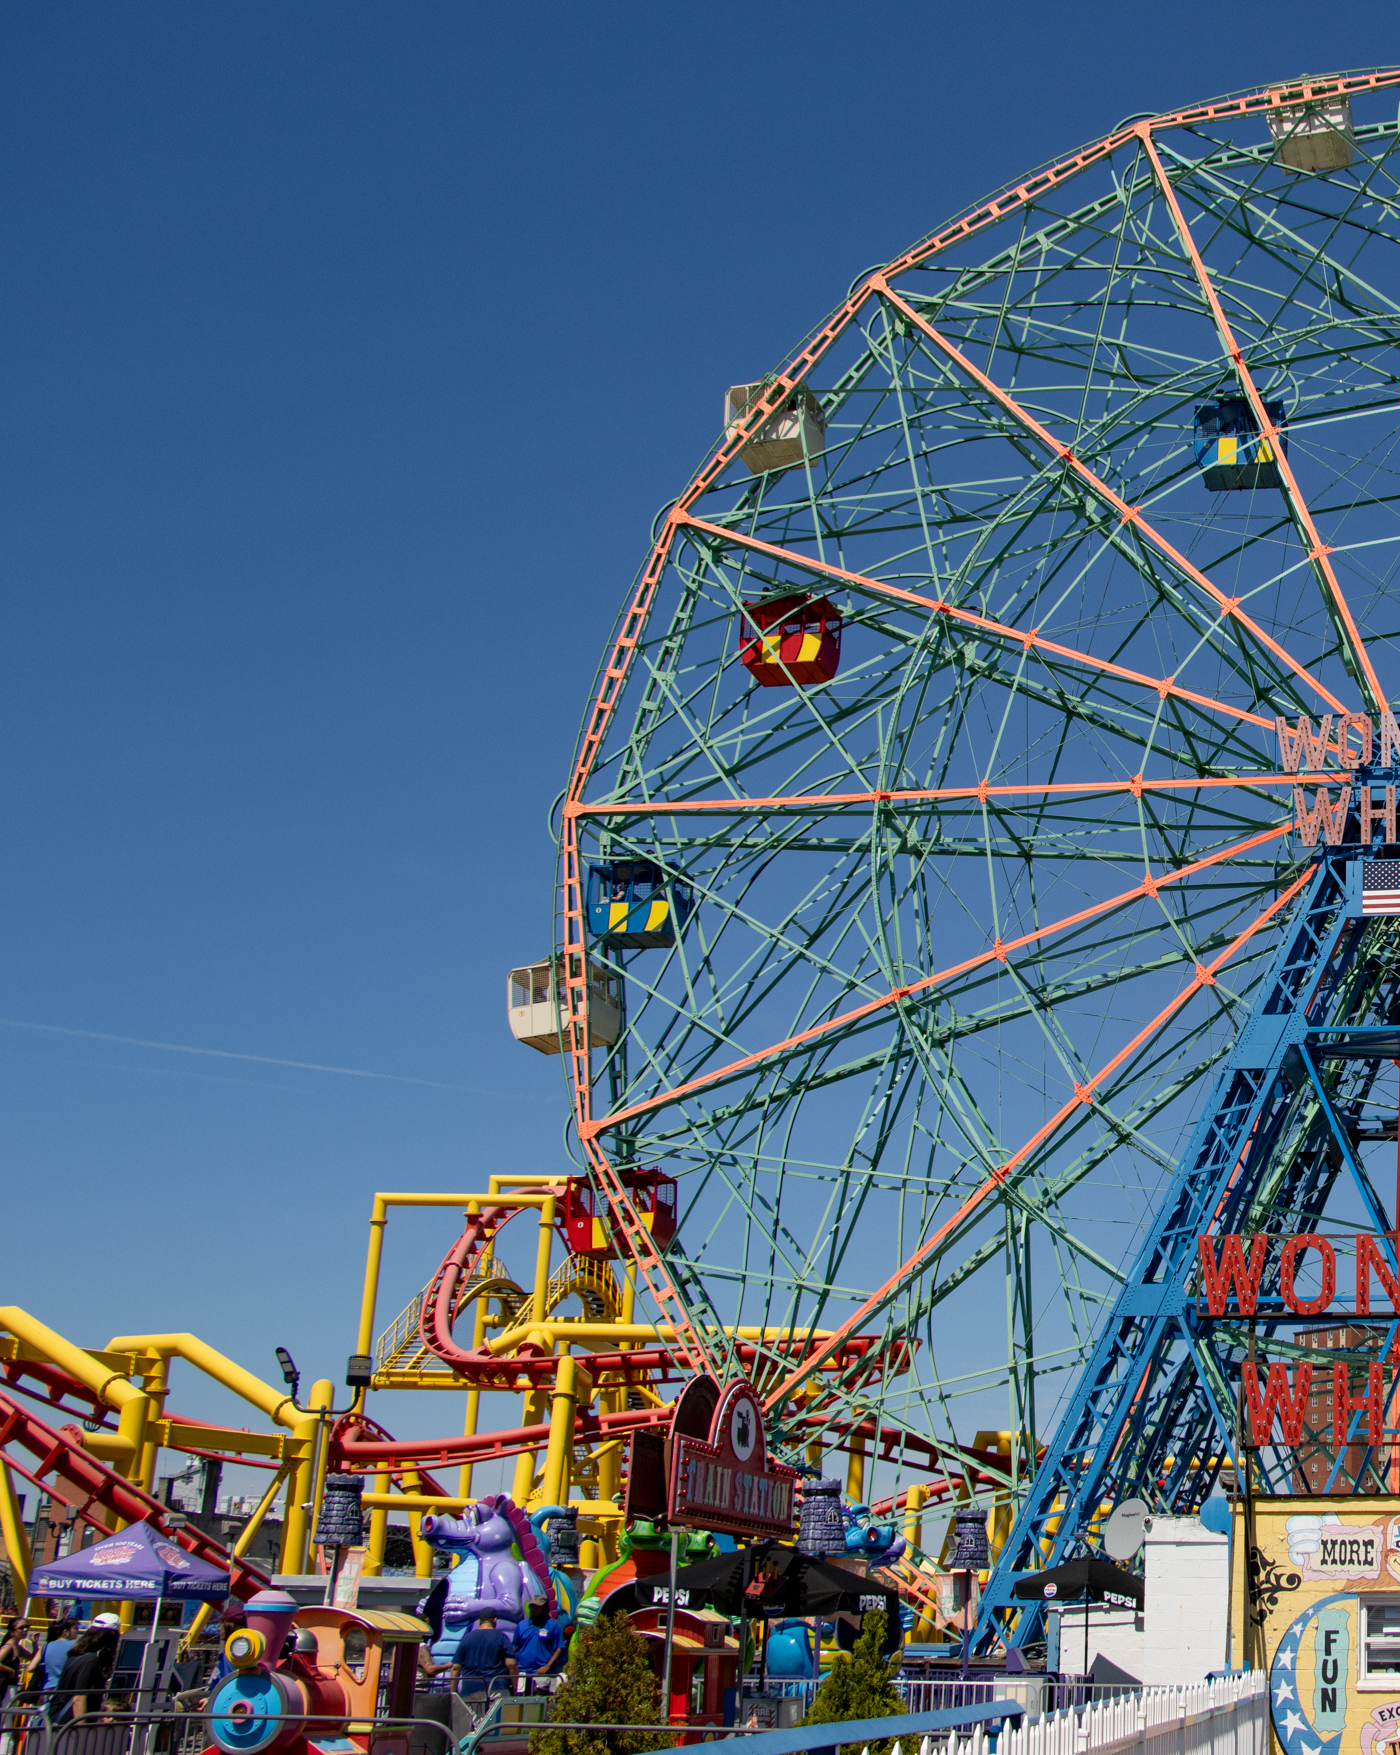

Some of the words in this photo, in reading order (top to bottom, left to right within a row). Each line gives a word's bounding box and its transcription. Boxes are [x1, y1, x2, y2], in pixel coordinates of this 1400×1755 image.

[686, 1459, 732, 1510] TRAIN
[734, 1470, 790, 1521] STATION
[94, 1543, 114, 1551] OVER
[127, 1541, 145, 1550] YEARS
[1320, 1538, 1374, 1567] MORE
[49, 1580, 72, 1589] BUY
[75, 1580, 123, 1589] TICKETS
[125, 1579, 156, 1589] HERE
[187, 1582, 212, 1591] TICKETS
[212, 1583, 228, 1591] HERE
[859, 1595, 887, 1611] PEPSI
[1104, 1590, 1137, 1609] PEPSI
[1321, 1630, 1339, 1712] FUN
[753, 1708, 770, 1716] FIRE
